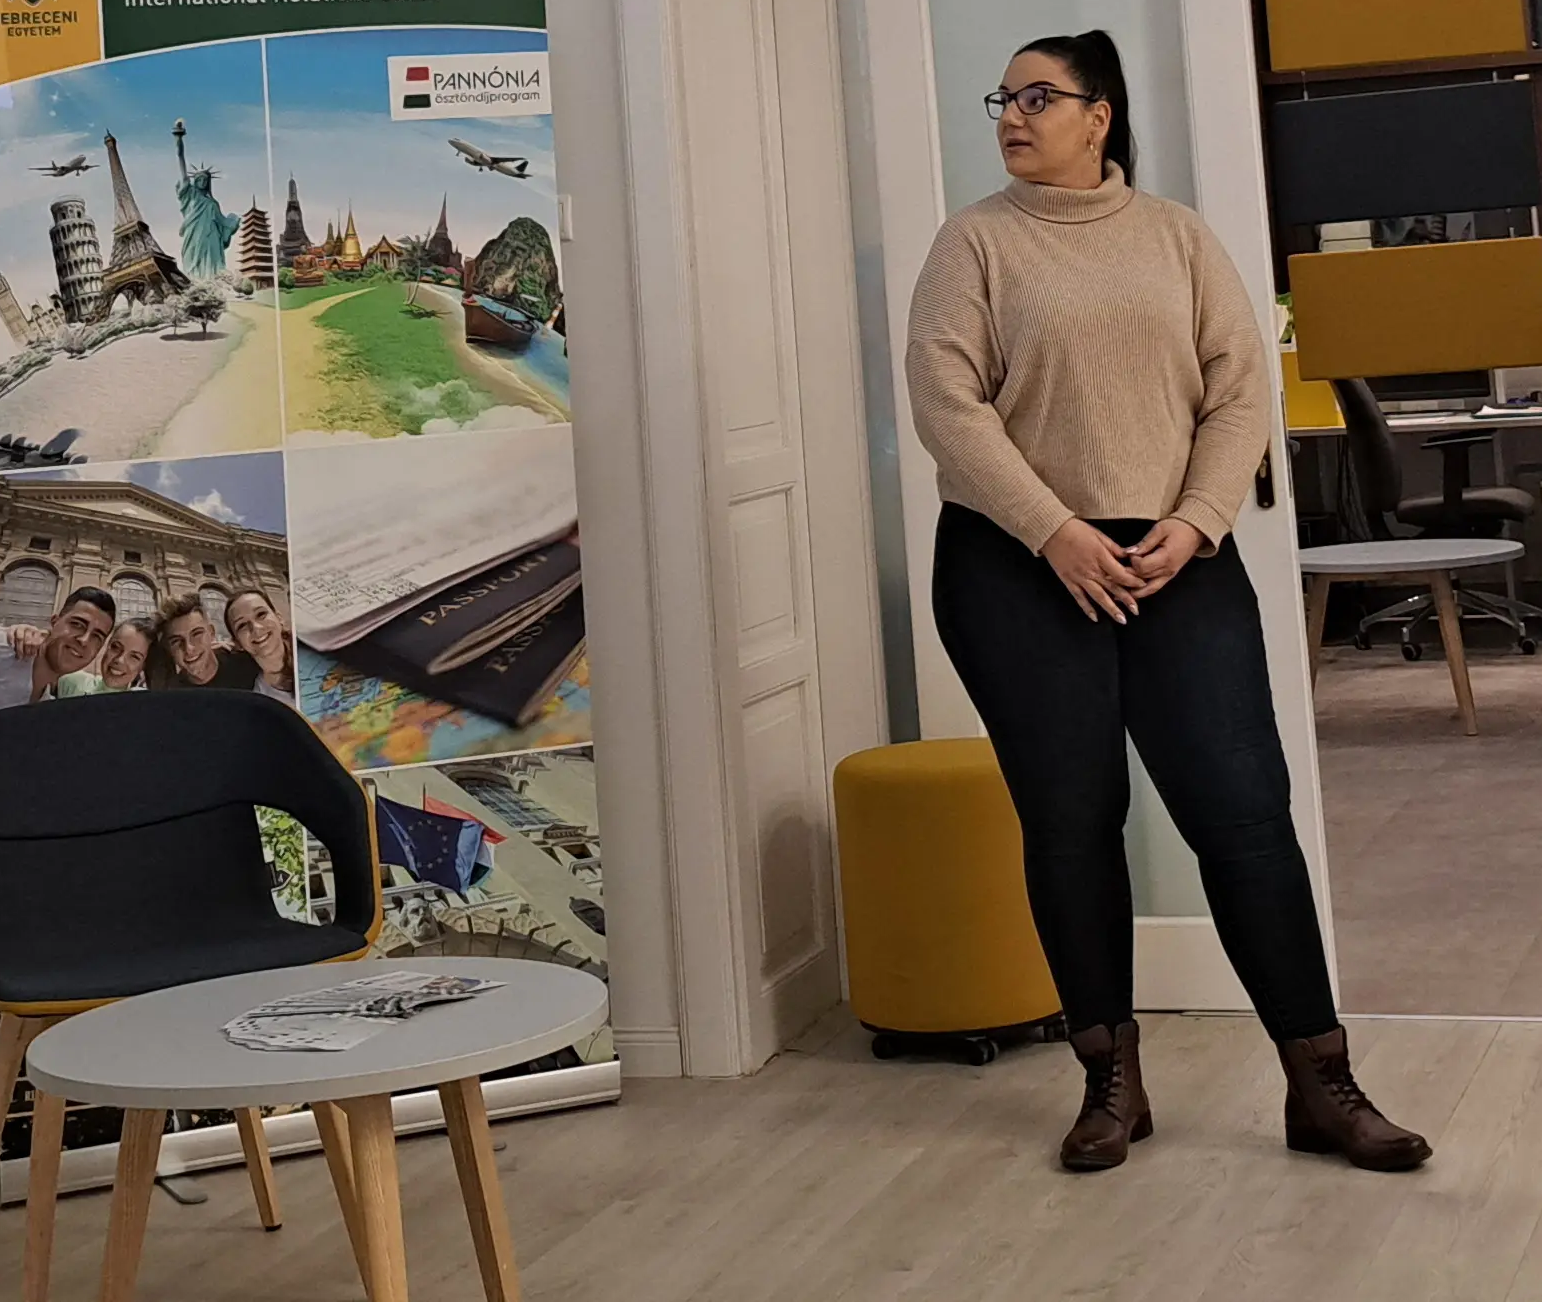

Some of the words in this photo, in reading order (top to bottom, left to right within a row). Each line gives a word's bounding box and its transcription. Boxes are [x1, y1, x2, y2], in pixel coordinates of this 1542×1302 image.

[7, 25, 61, 38] EGYETEM
[433, 65, 540, 91] PANNÓNIA
[434, 91, 541, 105] ösztöndíjprogram
